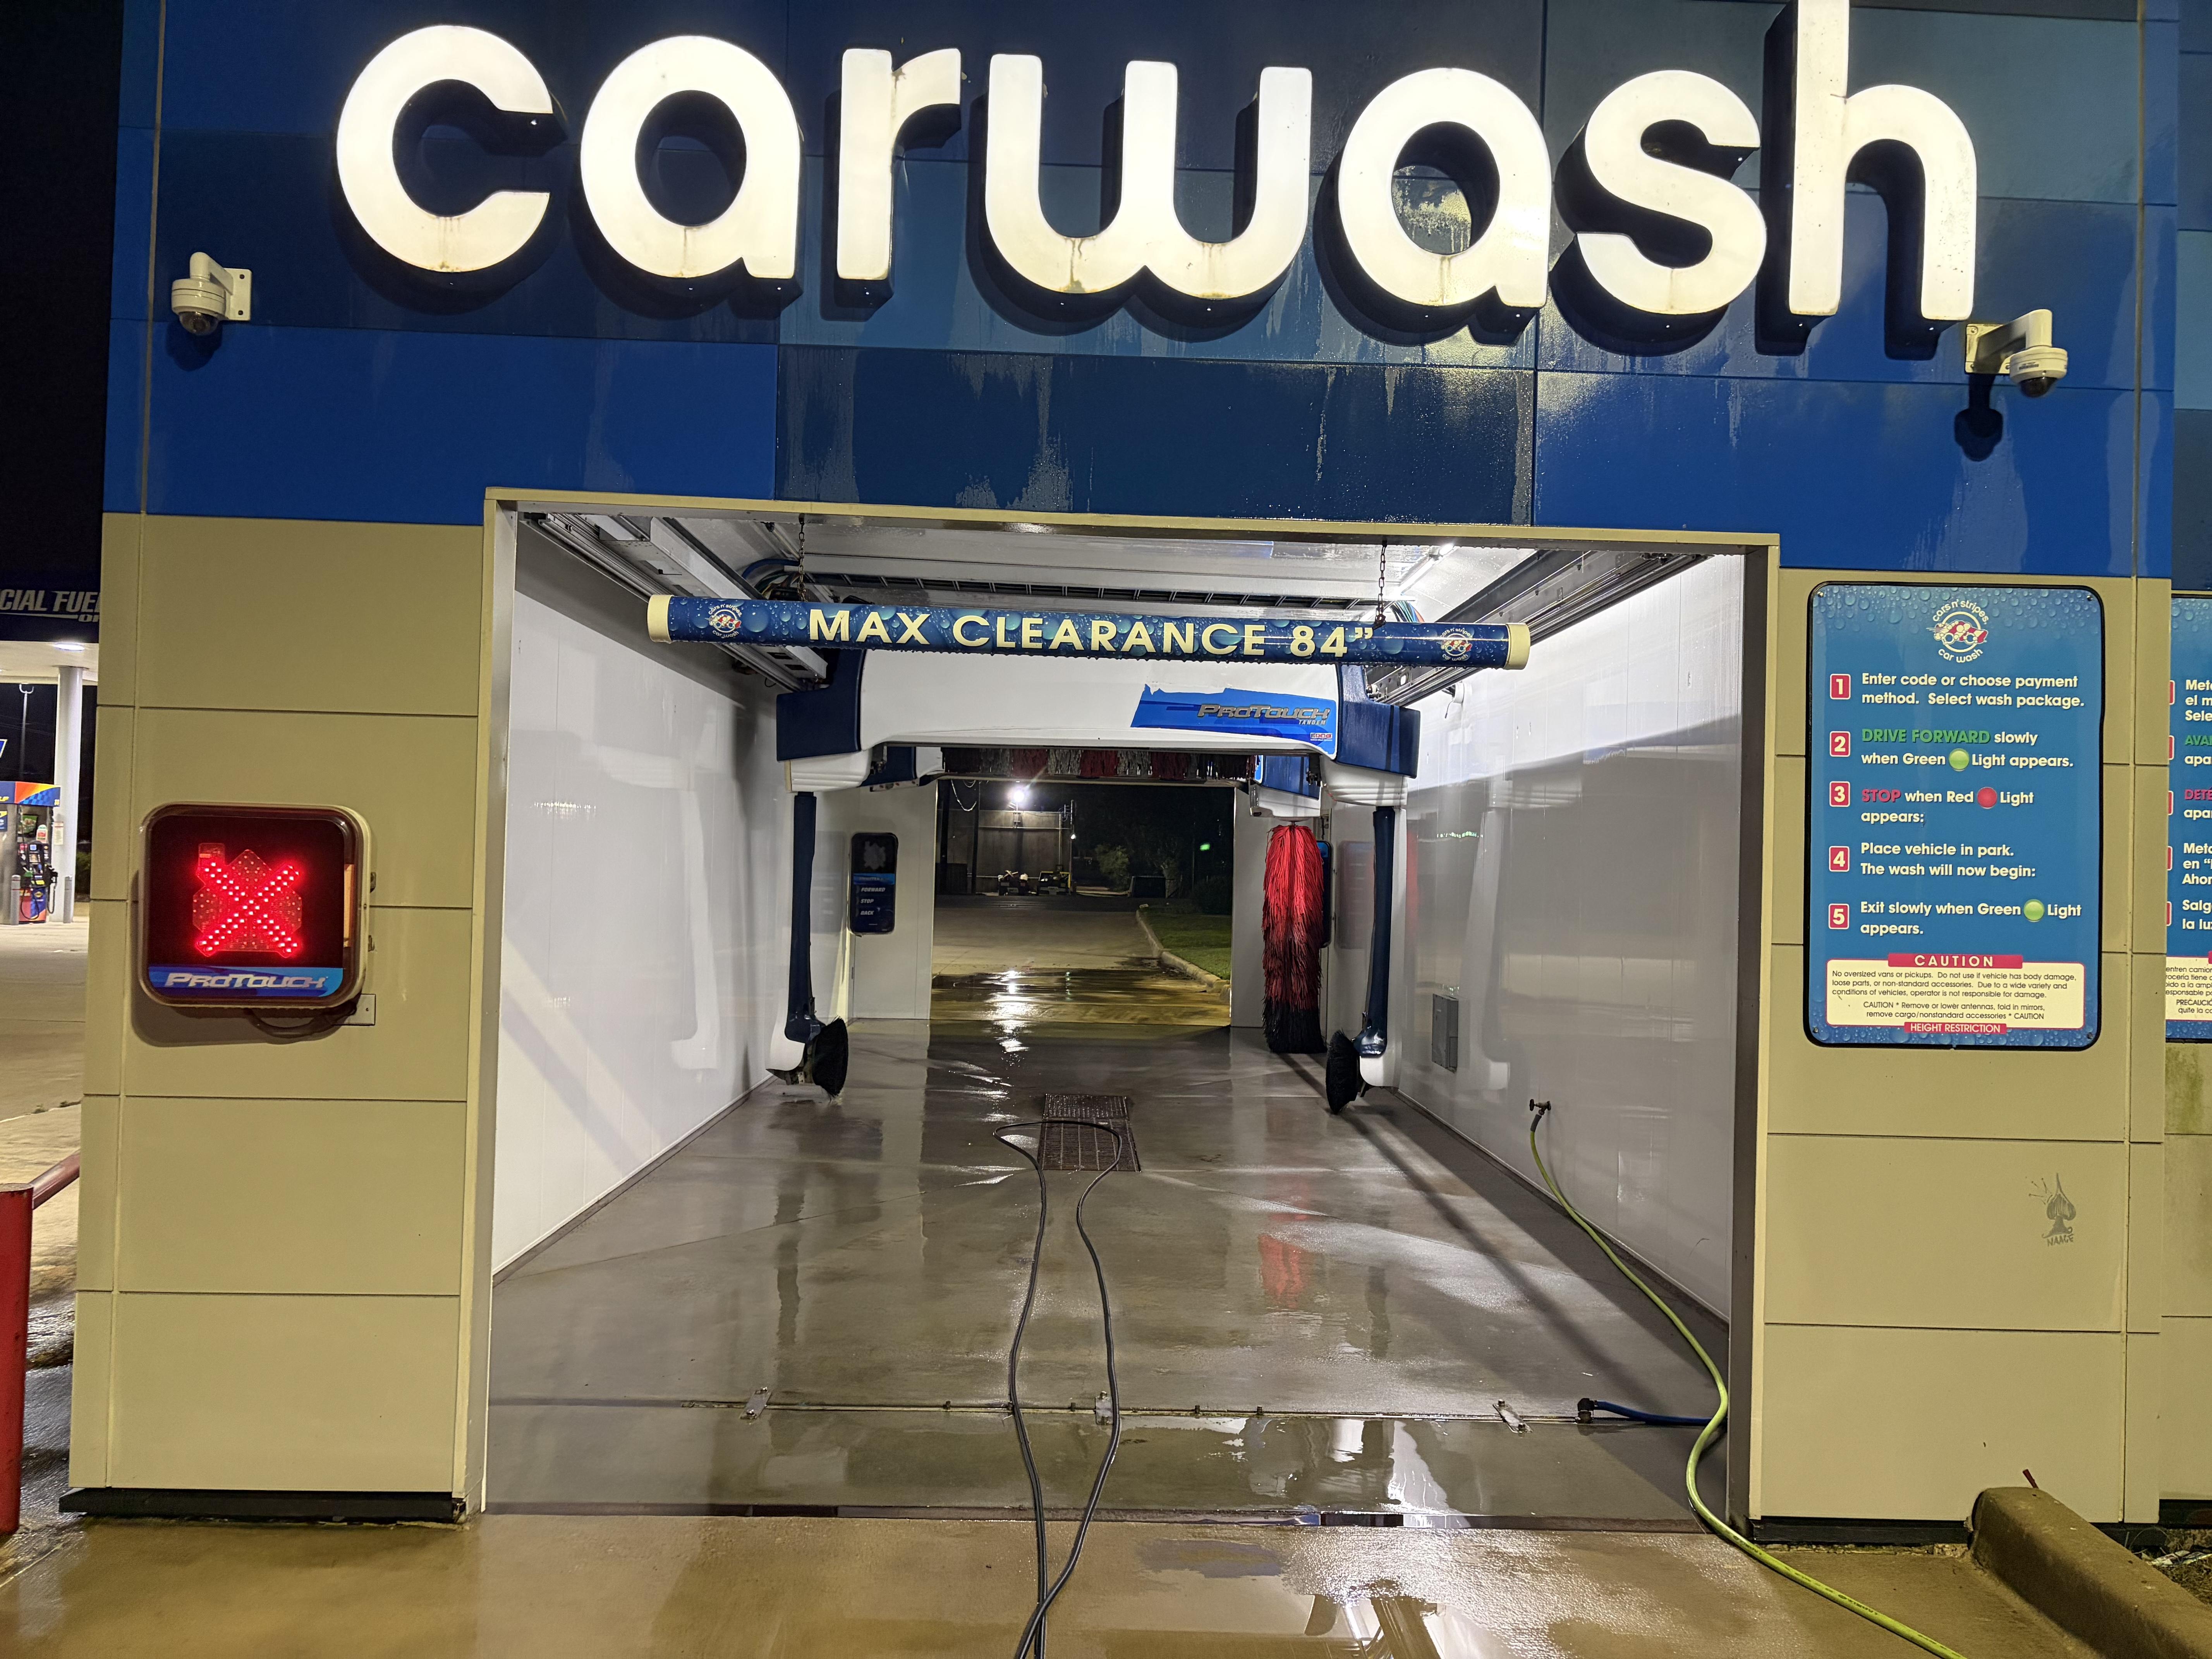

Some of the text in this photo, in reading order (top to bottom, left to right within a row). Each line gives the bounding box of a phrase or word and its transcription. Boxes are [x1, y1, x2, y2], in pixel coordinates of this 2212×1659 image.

[335, 0, 1978, 321] carwash
[708, 606, 720, 614] cars
[726, 605, 742, 617] stripes
[1933, 604, 1951, 621] cars
[1960, 601, 1989, 622] stripes
[810, 609, 930, 644] MAX
[953, 616, 1264, 656] CLEARANCE
[1938, 649, 1983, 663] car wash
[1836, 679, 1843, 694] 1
[1863, 673, 2078, 689] Enter code or choose payment
[1862, 692, 2084, 709] method. Select wash package.
[2185, 695, 2198, 705] el
[1834, 736, 1845, 752] 2
[1862, 730, 2038, 745] DRIVE FORWARD slowly
[1862, 753, 2073, 768] when Green Light appears.
[2185, 756, 2212, 766] apa
[1834, 786, 1846, 802] 3
[1862, 790, 2033, 806] STOP when Red Light
[1861, 813, 1923, 824] appears:
[2184, 809, 2212, 820] apa
[1862, 843, 2013, 857] Place vehicle in park.
[1833, 851, 1846, 867] 4
[2183, 860, 2200, 869] en
[1861, 863, 2035, 879] The wash will now begin:
[1861, 902, 2081, 919] Exit slowly when Green Light
[2183, 900, 2212, 914] Salg
[1833, 908, 1845, 924] 5
[1861, 925, 1923, 936] appears.
[2183, 919, 2195, 929] la
[1915, 955, 1994, 967] CAUTION
[1911, 1023, 2000, 1032] HEIGHT RESTRICTION
